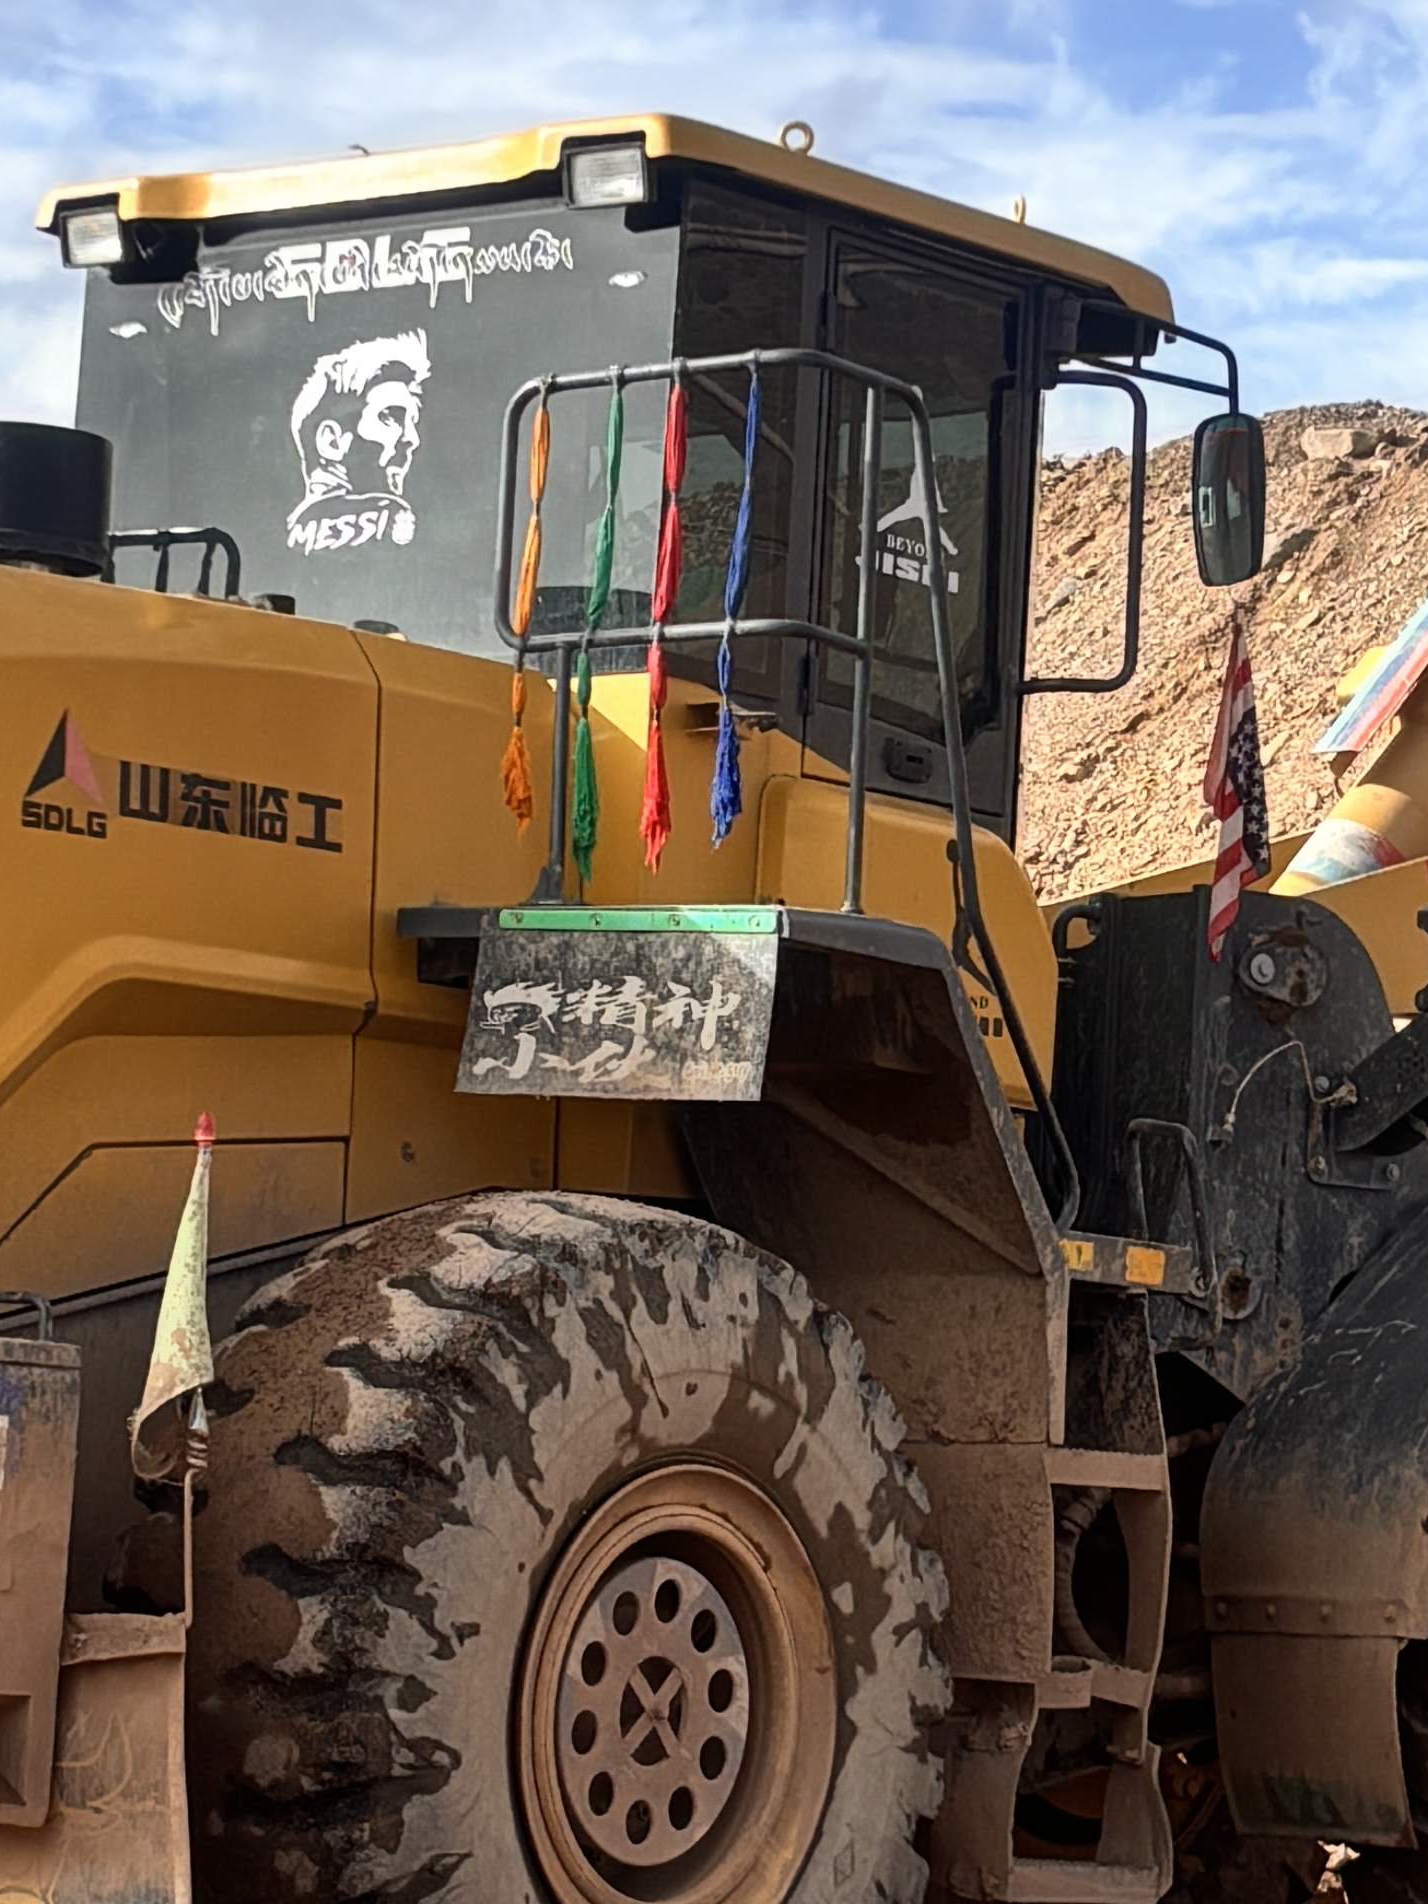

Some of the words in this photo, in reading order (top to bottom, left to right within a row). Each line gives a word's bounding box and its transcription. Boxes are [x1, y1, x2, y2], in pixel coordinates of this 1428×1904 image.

[287, 499, 390, 556] MESSI
[21, 800, 107, 840] SDLG
[118, 759, 343, 853] 山东临工
[562, 975, 741, 1050] 精神
